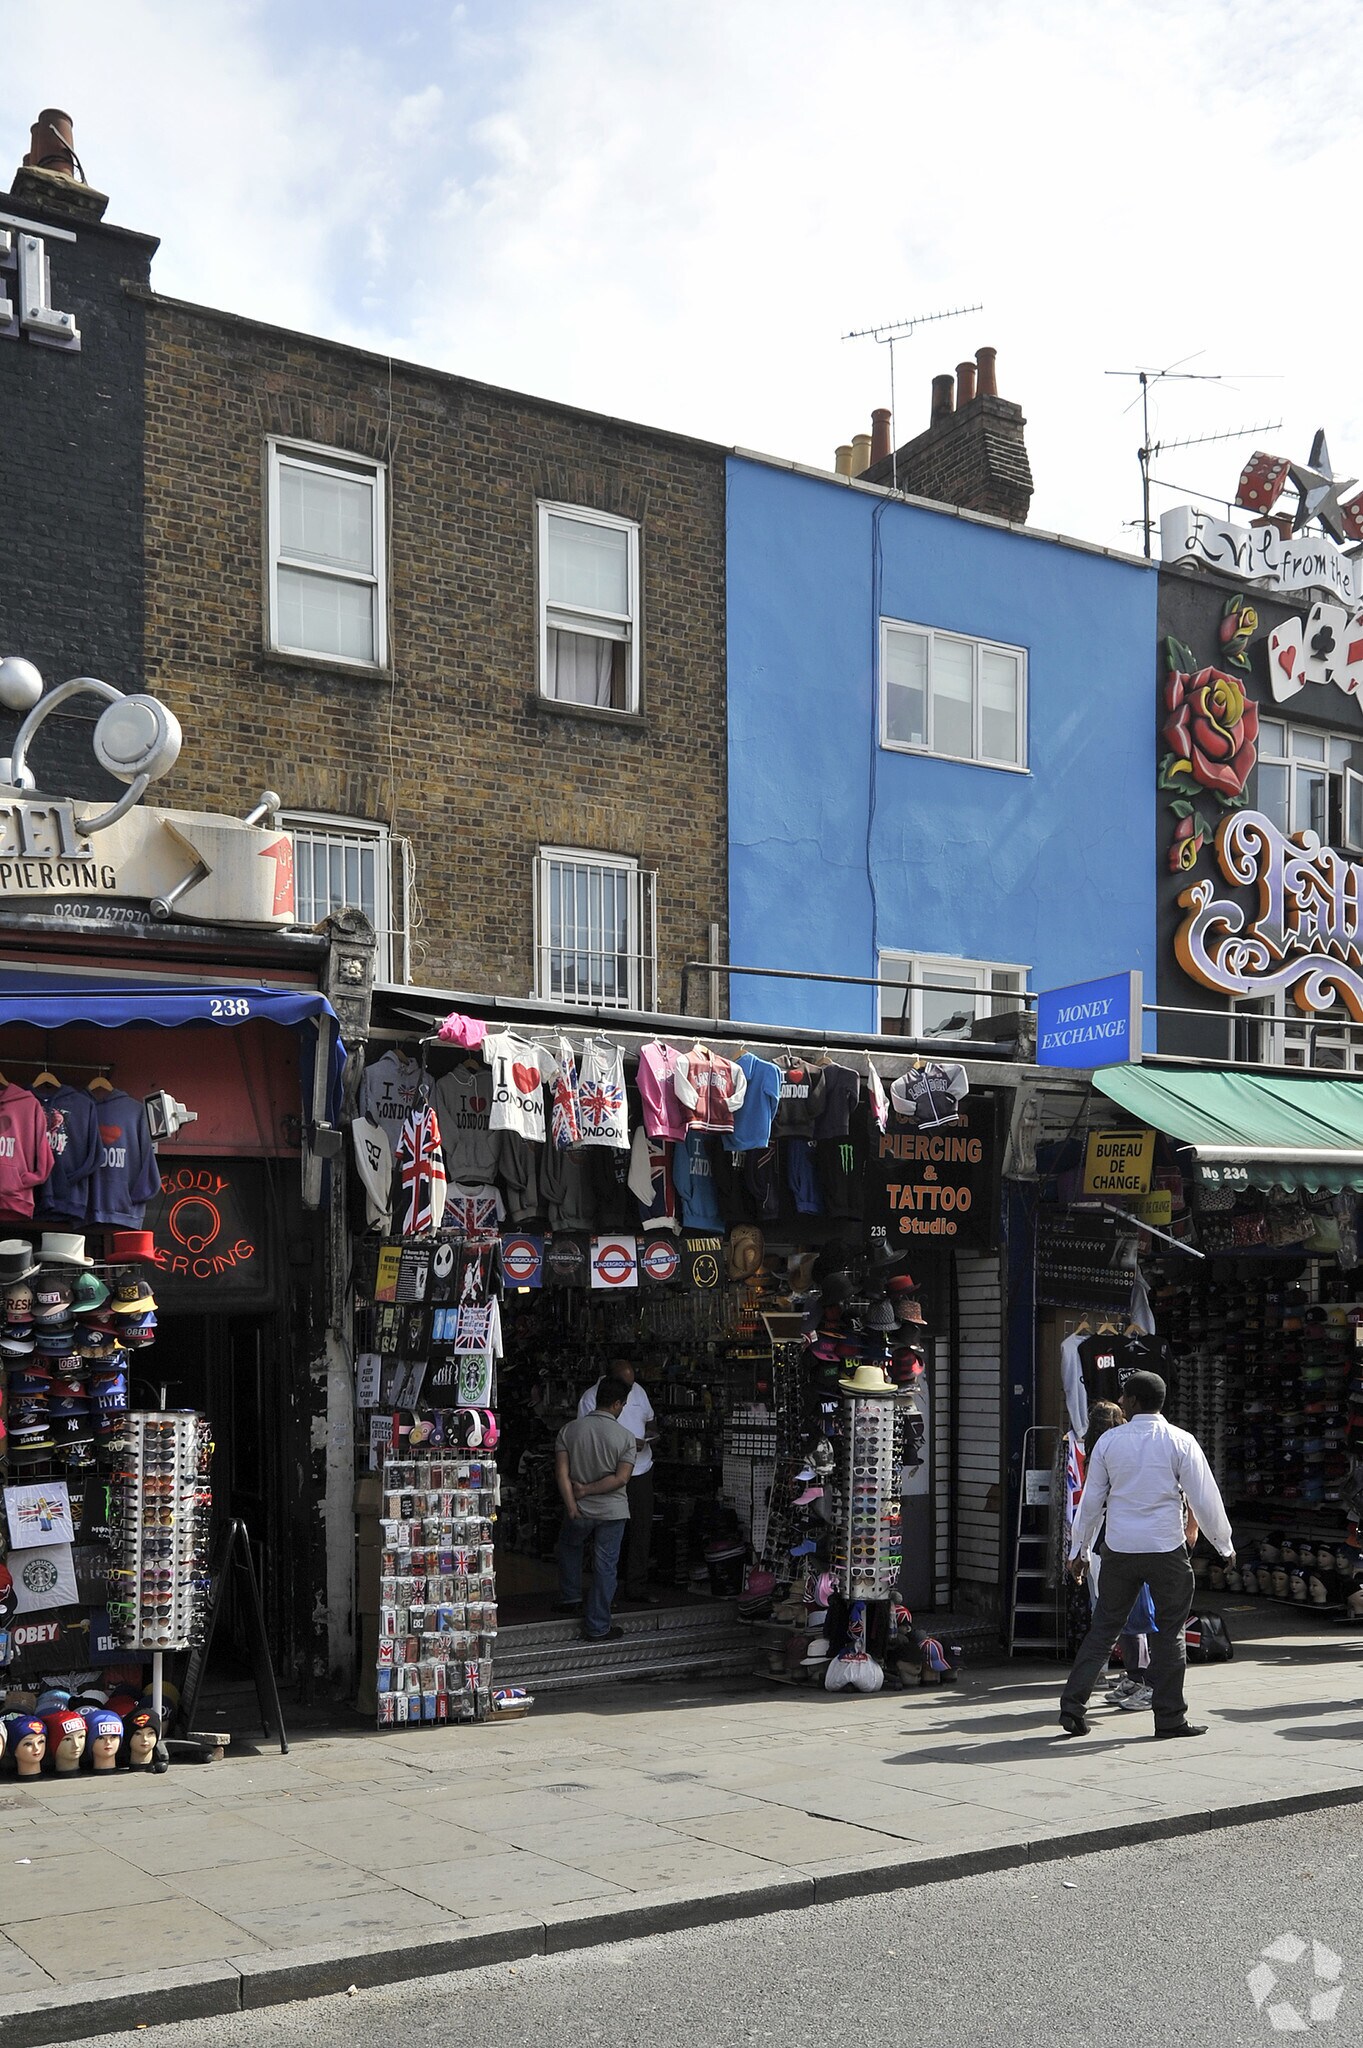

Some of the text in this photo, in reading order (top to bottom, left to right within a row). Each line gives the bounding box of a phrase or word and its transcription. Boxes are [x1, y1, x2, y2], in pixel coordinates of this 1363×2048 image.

[1185, 507, 1352, 597] Evil from the
[0, 863, 116, 890] PIERCING
[54, 903, 90, 918] 0207
[210, 999, 250, 1018] 238
[1056, 998, 1114, 1025] MONEY
[1041, 1019, 1127, 1050] EXCHANGE
[497, 1055, 508, 1088] I
[382, 1082, 394, 1100] I
[908, 1078, 948, 1100] LONDON
[460, 1095, 467, 1112] I
[492, 1089, 543, 1116] LONDON
[879, 1134, 983, 1164] PIERCING
[1096, 1144, 1142, 1158] BUREAU
[923, 1165, 938, 1181] &
[1110, 1159, 1125, 1173] DE
[1223, 1167, 1248, 1180] 234
[161, 1168, 231, 1196] BODY
[1093, 1175, 1140, 1189] CHANGE
[886, 1184, 972, 1212] TATTOO
[871, 1226, 887, 1237] 236
[899, 1216, 957, 1235] Studio
[99, 1394, 127, 1409] HYPE
[23, 1559, 57, 1578] STARBUCKS
[31, 1581, 55, 1593] COFFEE
[14, 1622, 59, 1645] OBEY
[66, 1719, 84, 1731] OBEY
[101, 1724, 121, 1734] OBEY
